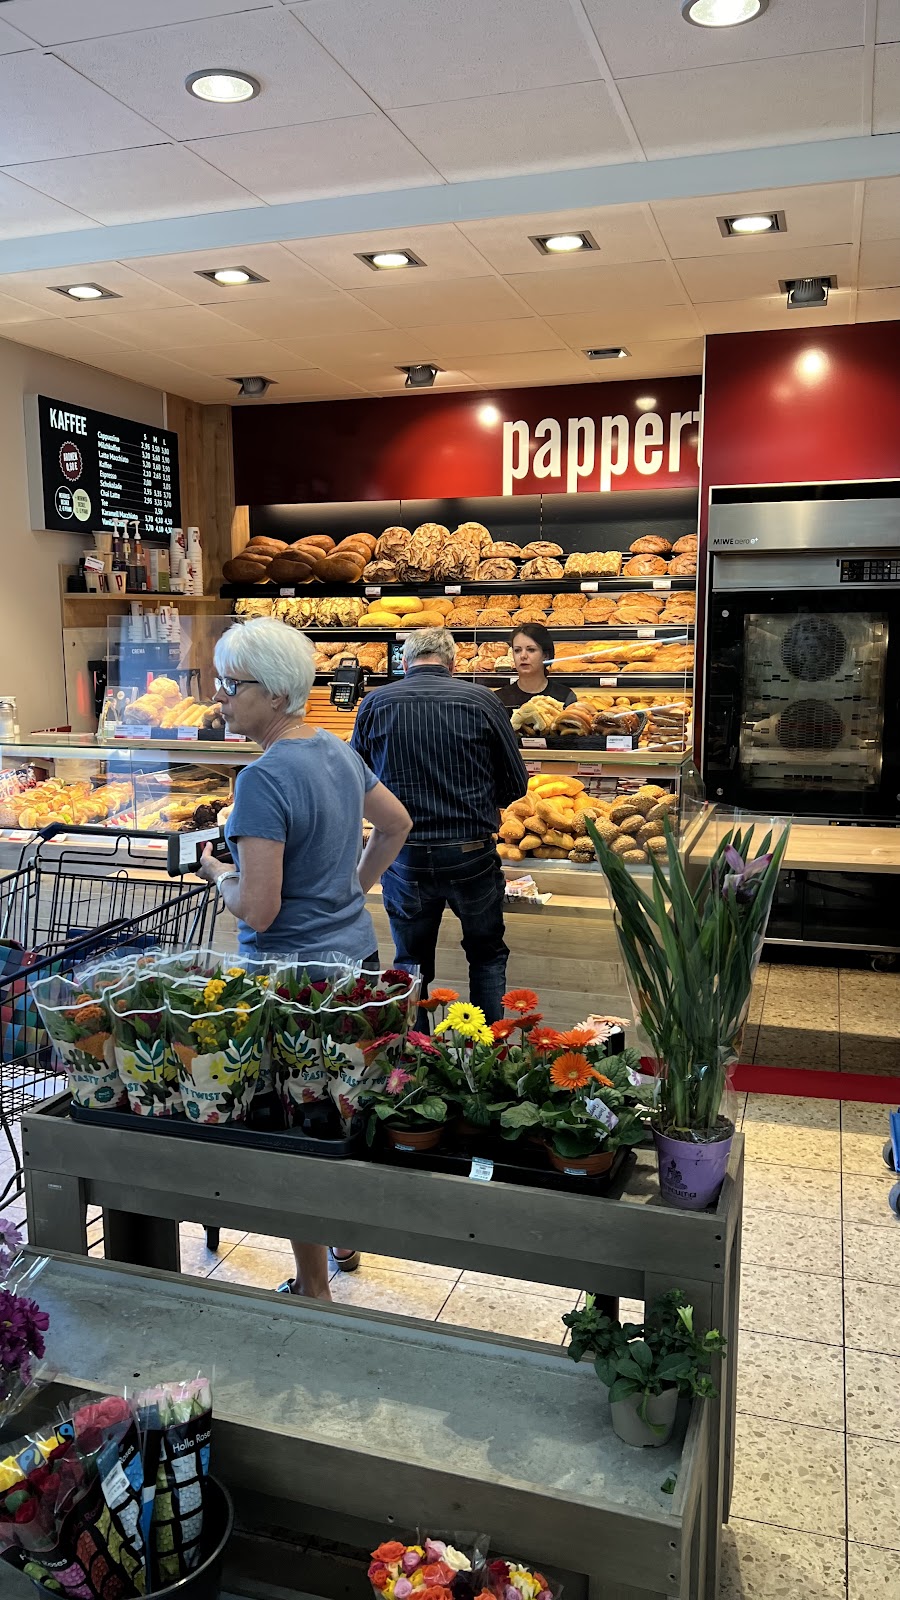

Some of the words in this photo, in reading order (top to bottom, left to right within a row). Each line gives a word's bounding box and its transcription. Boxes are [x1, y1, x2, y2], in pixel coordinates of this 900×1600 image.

[50, 408, 87, 436] KAFFEE
[97, 430, 120, 442] Cappuccino
[98, 440, 120, 452] Milchkaffee
[98, 450, 109, 459] Latte
[109, 453, 129, 464] Macchiato
[99, 460, 112, 469] Kaffee
[100, 470, 117, 480] Espresso
[100, 480, 122, 490] Schokolade
[100, 489, 109, 497] Chai
[110, 491, 120, 499] Latte
[101, 508, 120, 517] Karamell
[120, 511, 138, 520] Macchiato
[72, 1074, 100, 1085] TASTY
[190, 1090, 220, 1101] TWIST
[172, 1437, 195, 1454] Holla
